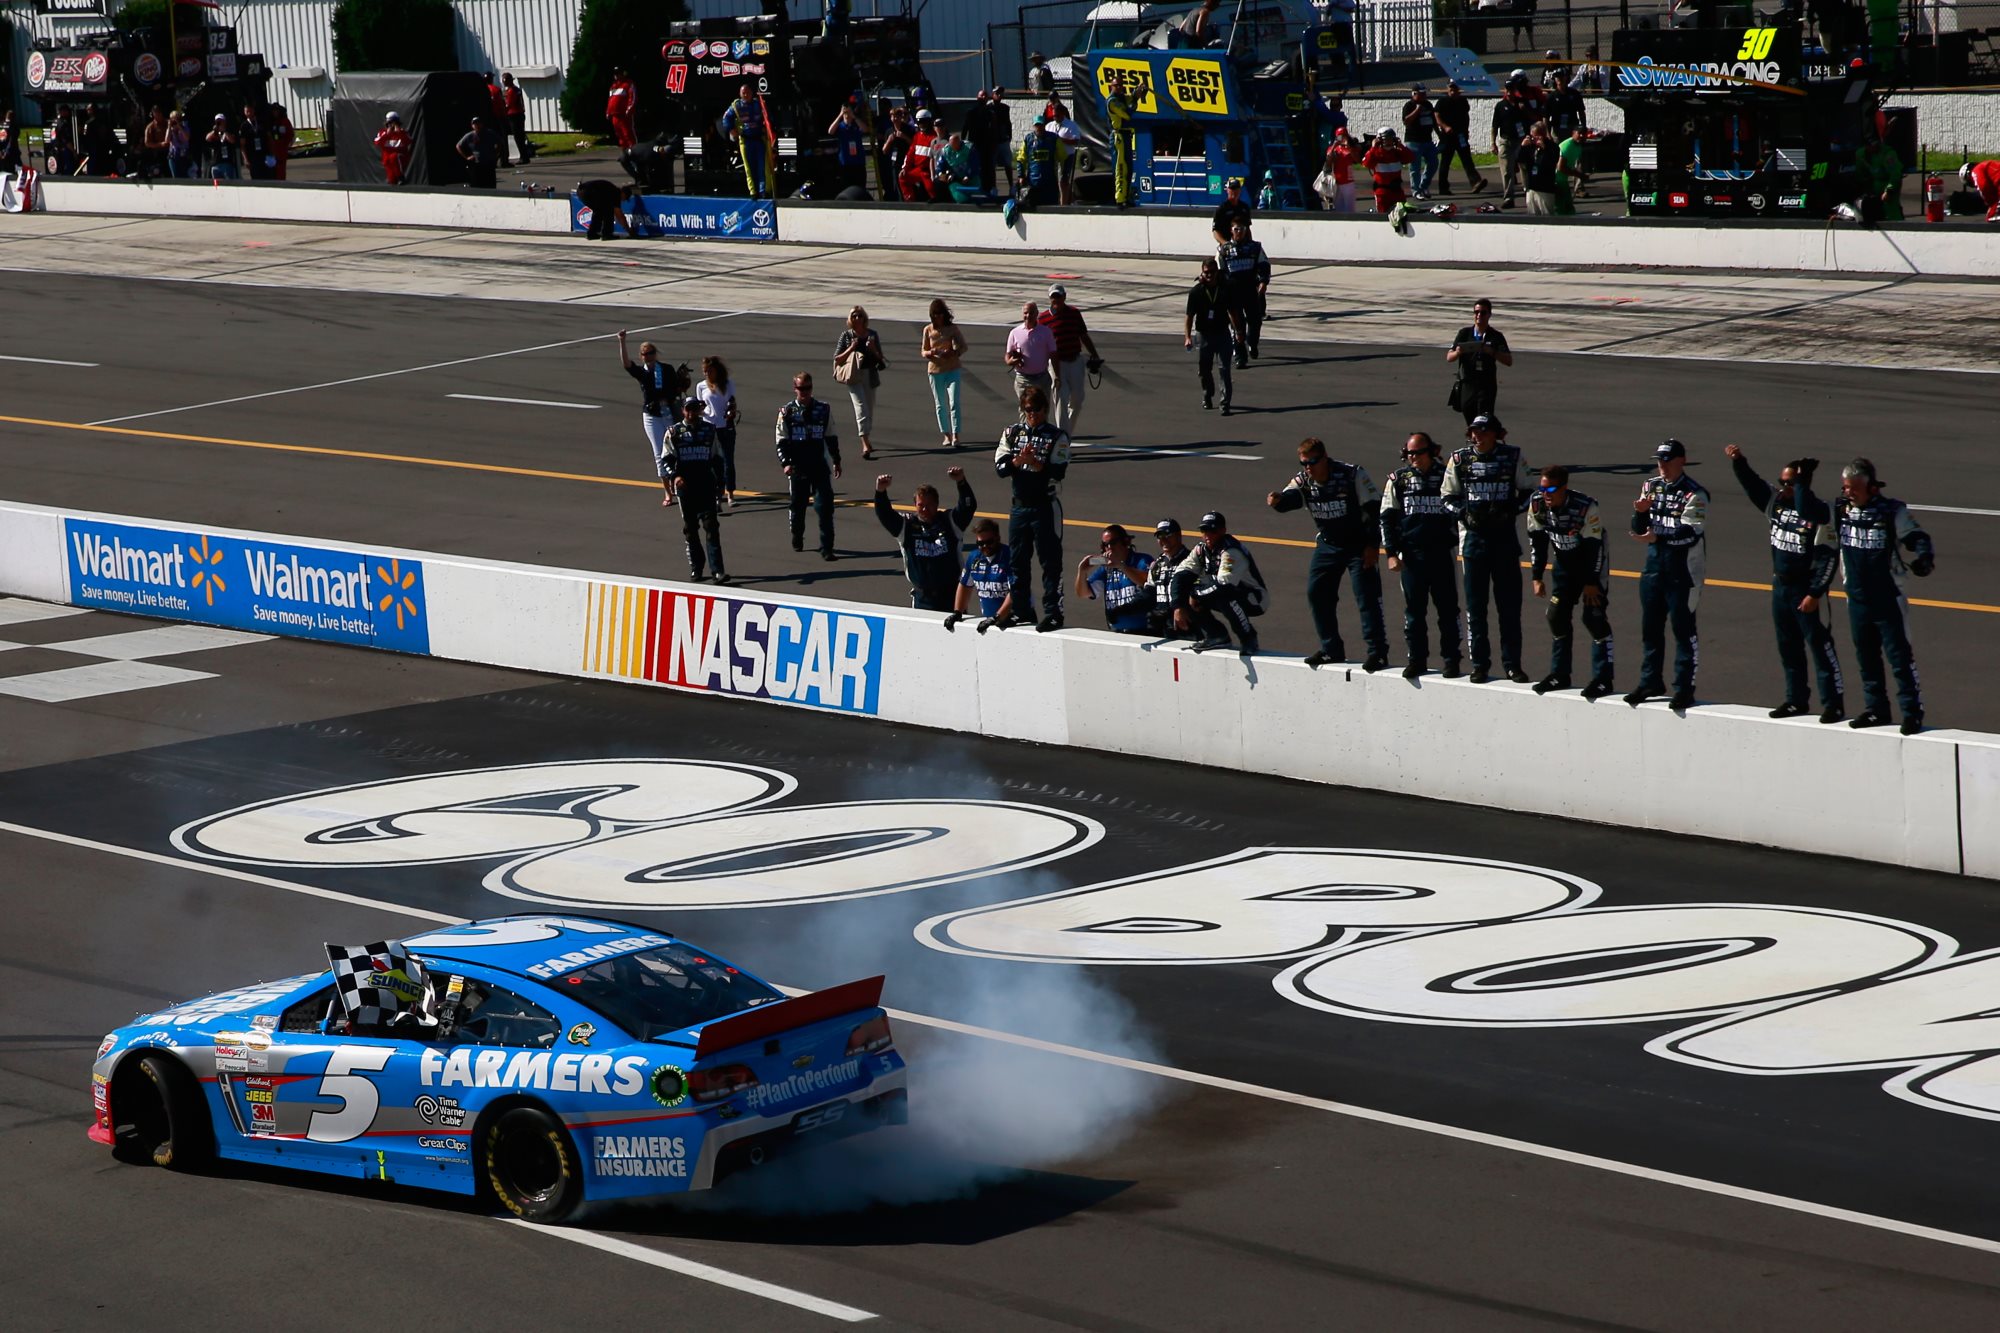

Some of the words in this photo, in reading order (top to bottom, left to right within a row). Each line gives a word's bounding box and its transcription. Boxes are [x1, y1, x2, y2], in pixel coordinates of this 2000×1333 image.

[1737, 28, 1778, 60] 30
[51, 58, 83, 77] BK
[702, 65, 721, 74] Charter
[1103, 67, 1150, 86] BEST
[44, 80, 84, 93] BKRacing.com
[666, 64, 687, 93] 47
[1172, 68, 1220, 87] BEST
[1178, 86, 1219, 105] BUY
[1811, 163, 1828, 180] 30
[1778, 194, 1807, 208] Lean1
[659, 214, 677, 228] Roll
[681, 215, 703, 229] With
[706, 215, 716, 229] It!
[752, 227, 773, 235] TOYOTA
[73, 531, 186, 588] Walmart
[245, 549, 373, 611] Walmart
[81, 583, 103, 599] Save
[138, 589, 157, 606] Live
[159, 593, 190, 611] better.
[254, 605, 278, 623] Save
[279, 610, 316, 630] money.
[318, 613, 339, 630] Live
[341, 616, 377, 636] better.
[669, 595, 871, 709] NASCAR
[169, 757, 1106, 910] GO
[525, 934, 671, 979] FARMERS
[128, 1031, 178, 1047] GOODYEAR
[420, 1047, 647, 1096] FARMERS
[651, 1064, 687, 1082] AMERICAN
[880, 1056, 892, 1072] 5
[306, 1043, 398, 1143] 5
[746, 1059, 860, 1110] #PlanToPerform
[246, 1091, 272, 1103] JEGS
[438, 1097, 457, 1107] Time
[652, 1092, 687, 1108] ETHANOL
[252, 1104, 274, 1120] 3M
[439, 1106, 465, 1117] Warner
[440, 1116, 461, 1126] Cable
[418, 1137, 445, 1148] Great
[446, 1138, 467, 1152] Clips
[593, 1136, 685, 1158] FARMERS
[594, 1159, 687, 1177] INSURANCE
